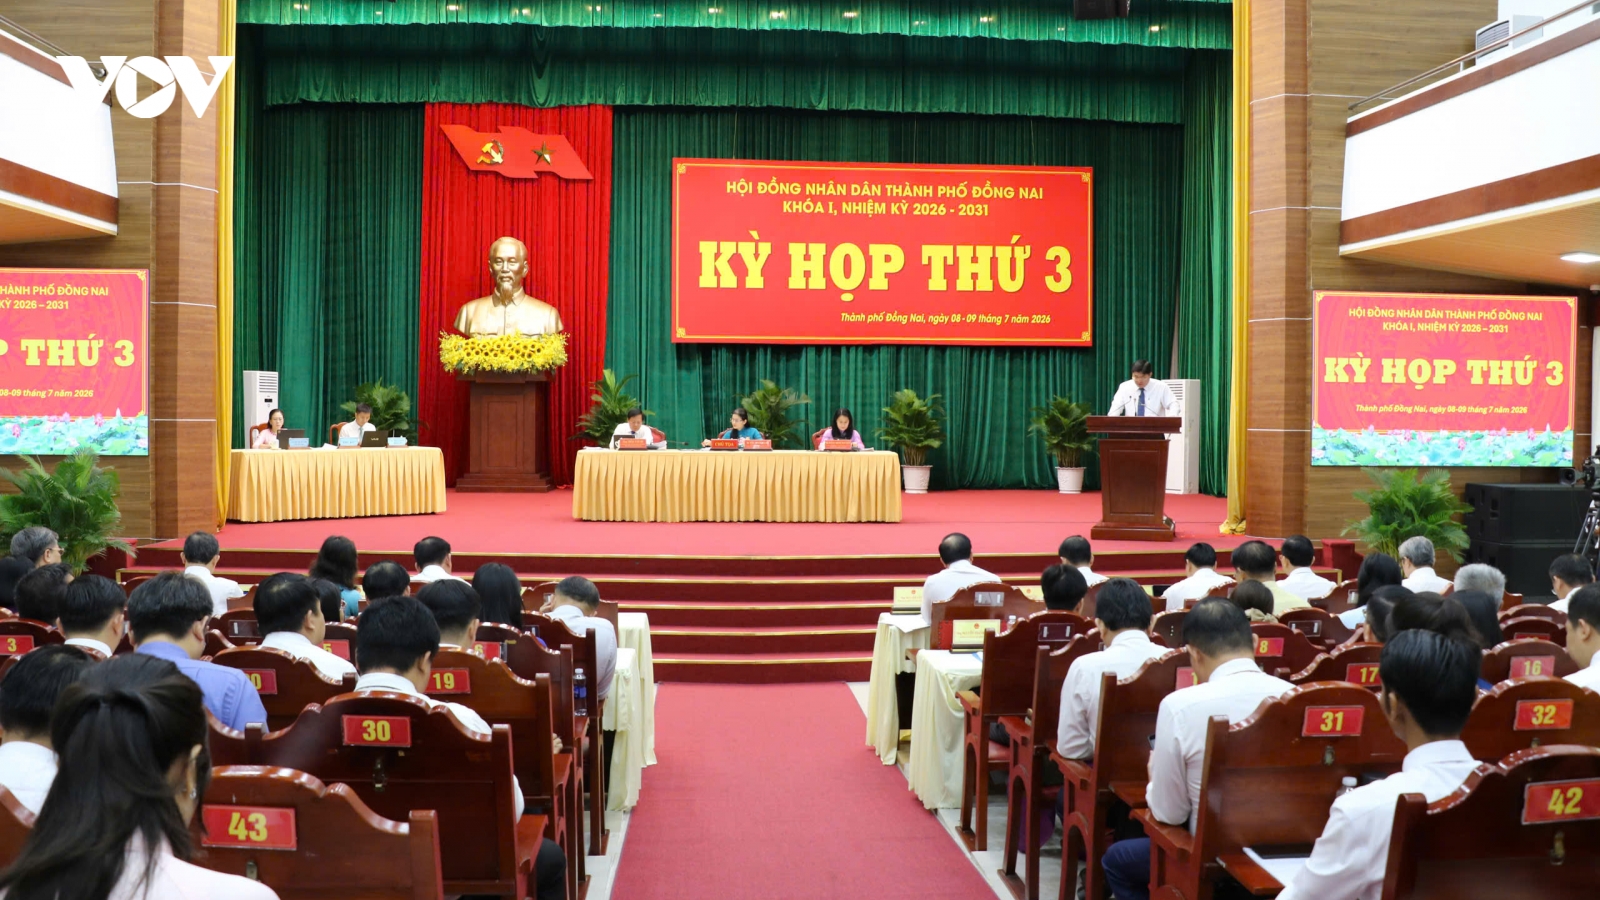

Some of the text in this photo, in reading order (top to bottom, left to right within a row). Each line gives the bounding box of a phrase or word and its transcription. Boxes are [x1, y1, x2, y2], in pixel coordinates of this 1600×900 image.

[726, 176, 1043, 199] HỘI ĐỒNG NHÂN DÂN THÀNH PHỐ ĐỒNG NAI
[783, 198, 824, 214] KHÓA
[828, 201, 838, 216] I,
[842, 199, 886, 217] NHIỆM
[891, 199, 909, 215] KỲ
[913, 203, 946, 216] 2026
[958, 204, 989, 216] 2031
[699, 230, 1073, 302] KỲ HỌP THỨ 3
[0, 282, 109, 296] HÀNH PHỐ ĐỒNG NAI
[13, 300, 37, 309] 2026
[46, 300, 69, 310] 2031
[1349, 305, 1543, 321] HỘI ĐỒNG NHÂN DÂN THÀNH PHỐ ĐỒNG NAI
[841, 312, 865, 322] Thành
[867, 311, 885, 324] phố
[886, 311, 908, 325] Đồng
[909, 313, 926, 324] Nai,
[928, 313, 949, 325] ngày
[978, 313, 1002, 326] tháng
[1004, 314, 1010, 323] 7
[1011, 314, 1029, 324] năm
[1031, 314, 1051, 324] 2026
[1383, 320, 1409, 331] KHÓA
[1410, 322, 1416, 333] I,
[1417, 321, 1447, 333] NHIỆM
[1448, 321, 1460, 332] KỲ
[1461, 323, 1482, 332] 2026
[1489, 324, 1509, 333] 2031
[21, 334, 104, 367] THỨ
[114, 339, 135, 367] 3
[1324, 351, 1564, 390] KỲ HỌP THỨ 3
[23, 388, 47, 399] tháng
[48, 389, 53, 397] 7
[54, 389, 73, 397] năm
[74, 389, 94, 397] 2026
[1356, 404, 1378, 412] Thành
[1378, 404, 1394, 414] phố
[1394, 404, 1413, 414] Đồng
[1414, 405, 1428, 413] Nai,
[1429, 405, 1447, 415] ngày
[1447, 405, 1467, 413] 08-09
[1468, 405, 1488, 415] tháng
[1494, 406, 1510, 414] năm
[1511, 406, 1528, 414] 2026
[8, 638, 17, 652] 3
[323, 643, 332, 653] 5
[1260, 640, 1268, 653] 8
[1360, 667, 1379, 683] 17
[1524, 661, 1541, 676] 16
[246, 673, 262, 690] 0
[433, 672, 455, 690] 19
[1320, 711, 1344, 731] 31
[1531, 705, 1556, 725] 32
[362, 720, 391, 741] 30
[1547, 787, 1583, 815] 42
[228, 812, 268, 842] 43
